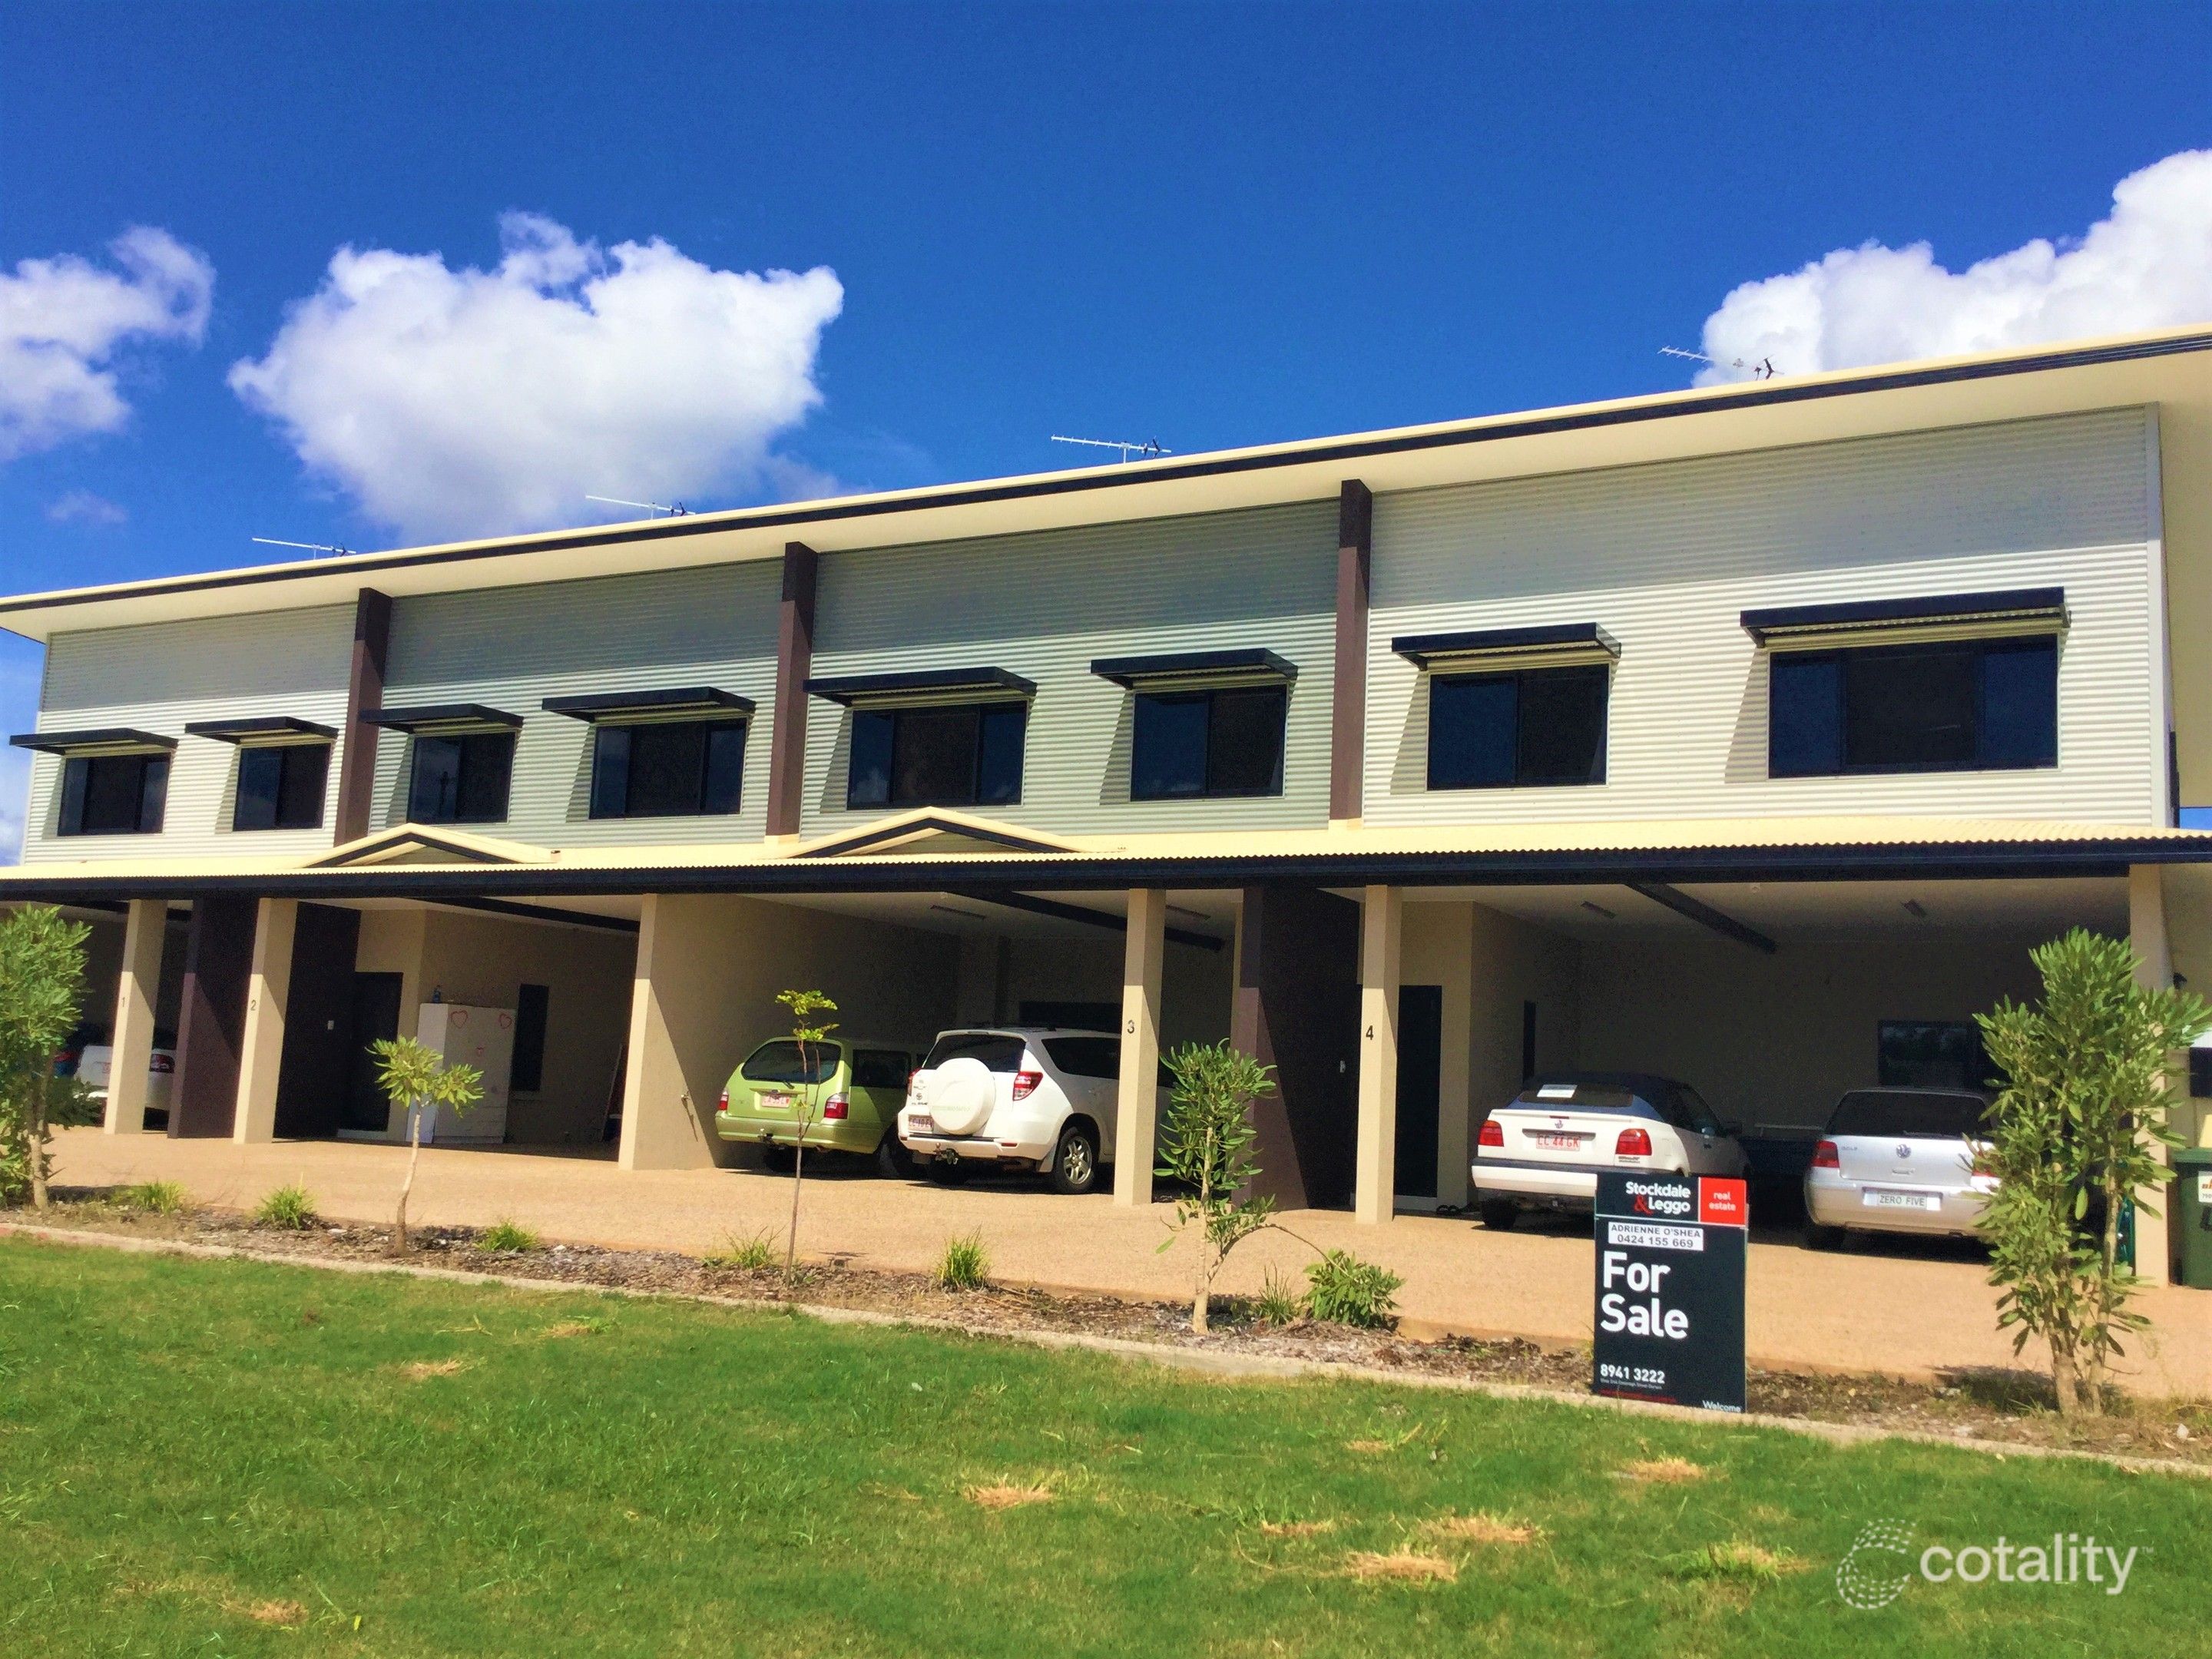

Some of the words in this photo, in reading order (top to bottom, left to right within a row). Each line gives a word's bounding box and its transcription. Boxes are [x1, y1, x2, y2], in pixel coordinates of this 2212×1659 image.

[121, 997, 127, 1008] 1
[250, 999, 257, 1012] 2
[1127, 1020, 1135, 1034] 3
[1366, 1025, 1374, 1040] 4
[1552, 1137, 1564, 1147] 44
[1625, 1181, 1691, 1198] Stockdale
[1713, 1191, 1731, 1200] real
[1634, 1194, 1654, 1216] &
[1647, 1196, 1690, 1215] Leggo
[1708, 1201, 1737, 1211] estate
[1879, 1195, 1902, 1204] ZERO
[1906, 1197, 1925, 1207] FIVE
[1611, 1224, 1661, 1234] ADRIENNE
[1664, 1228, 1700, 1237] O'SHEA
[1617, 1233, 1644, 1243] 0424
[1648, 1237, 1668, 1246] 155
[1672, 1238, 1694, 1247] 669
[1603, 1250, 1671, 1293] For
[1600, 1293, 1689, 1339] Sale
[1600, 1363, 1630, 1379] 8941
[1633, 1368, 1665, 1384] 3222
[1702, 1399, 1741, 1413] Welcome
